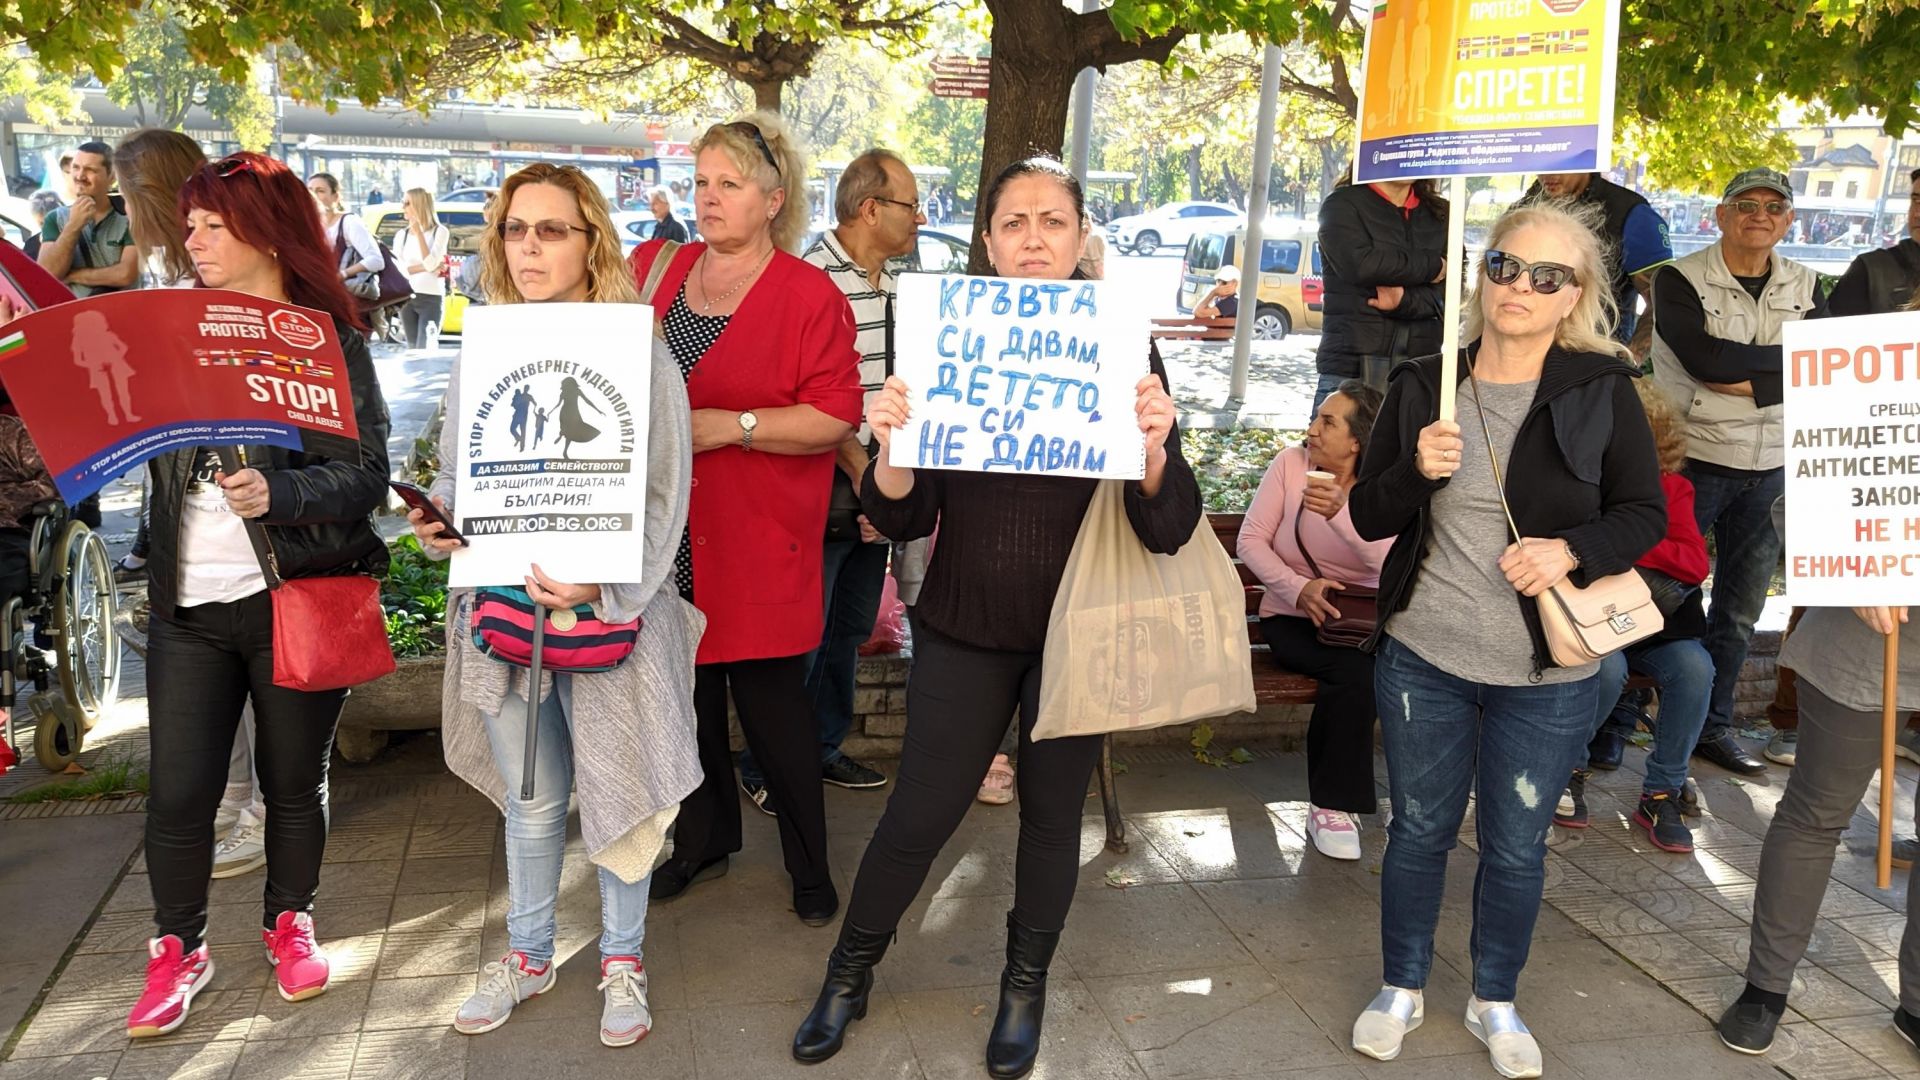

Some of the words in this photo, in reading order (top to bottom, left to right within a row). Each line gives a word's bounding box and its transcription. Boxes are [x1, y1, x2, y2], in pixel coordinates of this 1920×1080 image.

[1454, 64, 1586, 110] СПРЕТЕ!
[939, 278, 1097, 320] КРЪВТА
[198, 322, 267, 340] PROTEST
[280, 321, 314, 334] STOP
[937, 325, 986, 363] СИ
[1791, 343, 1920, 387] ПРОТ
[488, 359, 580, 402] БАРНЕВЕРНЕТ
[246, 373, 340, 417] STOP!
[287, 409, 314, 423] CHILD
[315, 415, 344, 430] ABUSE
[476, 401, 494, 420] НА
[580, 366, 635, 454] ИДЕОЛОГИЯТА
[980, 407, 1025, 433] СИ
[469, 422, 484, 458] STOP
[918, 420, 968, 466] НЕ
[982, 432, 1106, 472] ДАВАМ
[1792, 423, 1920, 449] АНТИДЕТС
[91, 455, 112, 473] STOP
[169, 426, 212, 437] IDEOLOGY
[218, 426, 245, 435] global
[245, 426, 288, 436] movement
[477, 465, 492, 475] ДА
[492, 462, 540, 474] ЗАПАЗИМ
[543, 460, 623, 472] СЕМЕЙСТВОТО!
[474, 479, 490, 492] ДА
[493, 477, 554, 491] ЗАЩИТИМ
[557, 476, 605, 489] ДЕЦАТА
[609, 477, 625, 487] НА
[504, 493, 592, 508] БЪЛГАРИЯ!
[472, 516, 622, 534] WWW.ROD-BG.ORG
[1855, 518, 1890, 542] НЕ
